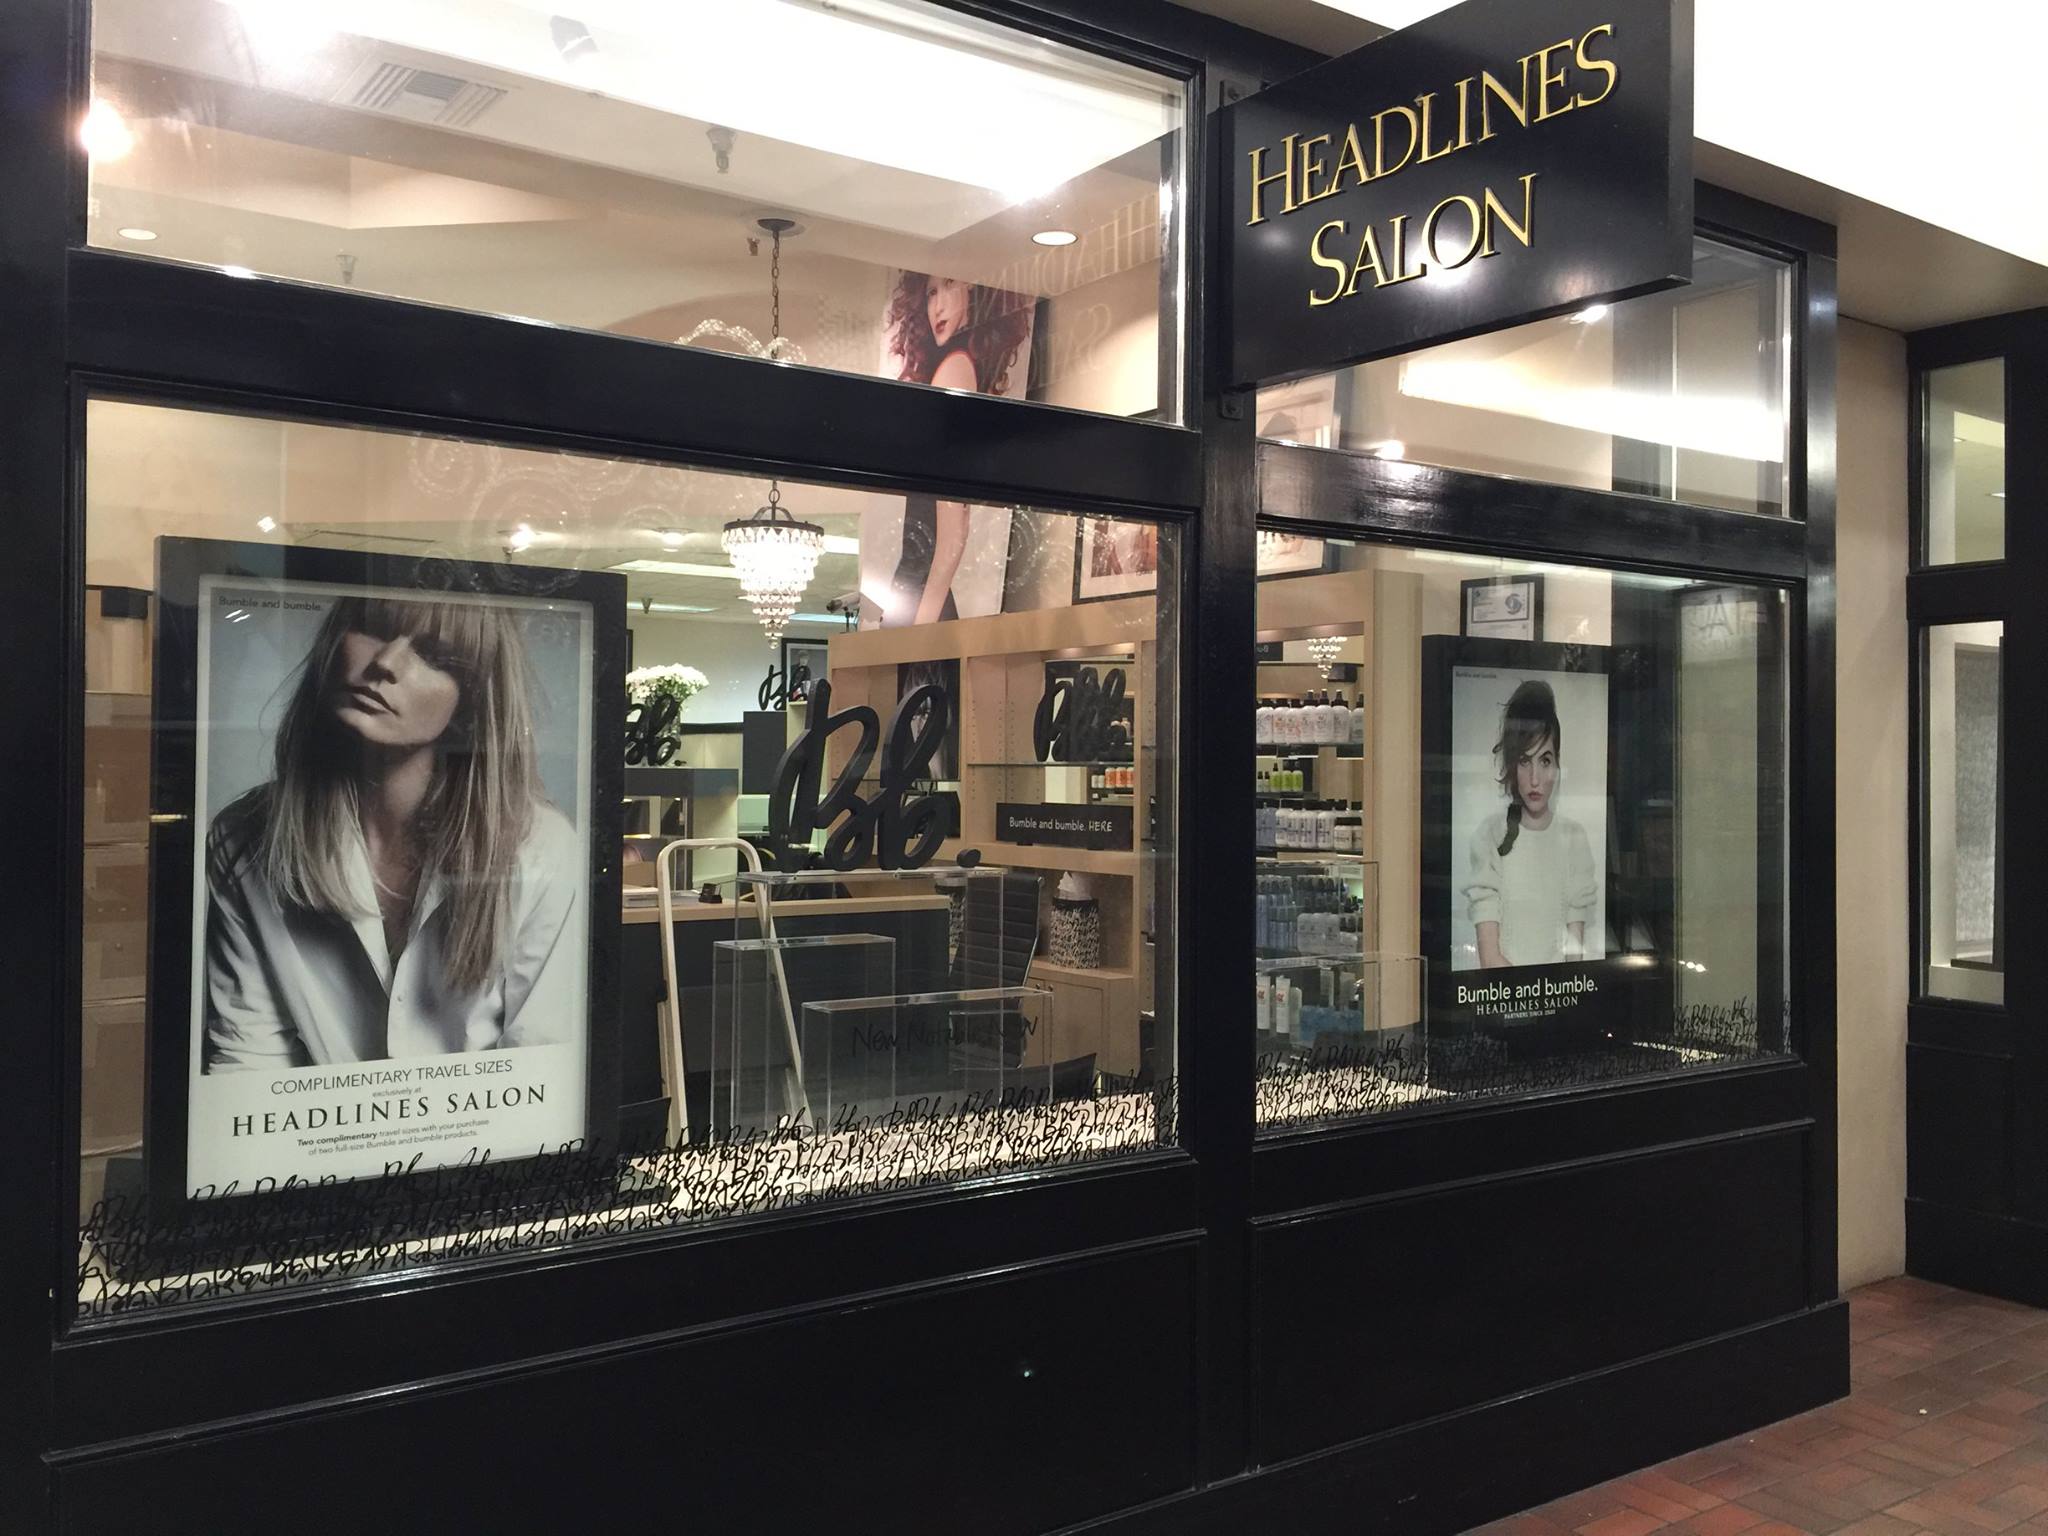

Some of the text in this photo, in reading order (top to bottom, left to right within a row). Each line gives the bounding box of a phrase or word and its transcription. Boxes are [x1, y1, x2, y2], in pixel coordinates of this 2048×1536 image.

[1246, 24, 1618, 227] HEADLINES
[1309, 173, 1538, 306] SALON
[218, 596, 258, 607] Bumble
[262, 600, 281, 609] and
[1009, 816, 1037, 829] Bumble
[1039, 818, 1053, 830] and
[1089, 820, 1113, 832] HERE
[1457, 974, 1599, 1004] Bumble and bumble.
[1476, 1000, 1540, 1016] HEADLINES
[1544, 995, 1579, 1009] SALON
[270, 1058, 513, 1096] COMPLIMENTARY TRAVEL SIZES
[372, 1086, 422, 1098] exclusively at
[231, 1083, 547, 1138] HEADLINES SALON
[297, 1118, 490, 1147] Two complimentary travel sizes with your purchase
[308, 1147, 317, 1156] of
[318, 1146, 334, 1154] two
[335, 1141, 366, 1153] full-size
[366, 1138, 397, 1150] Bumble
[397, 1135, 412, 1146] and
[413, 1133, 442, 1144] bumble
